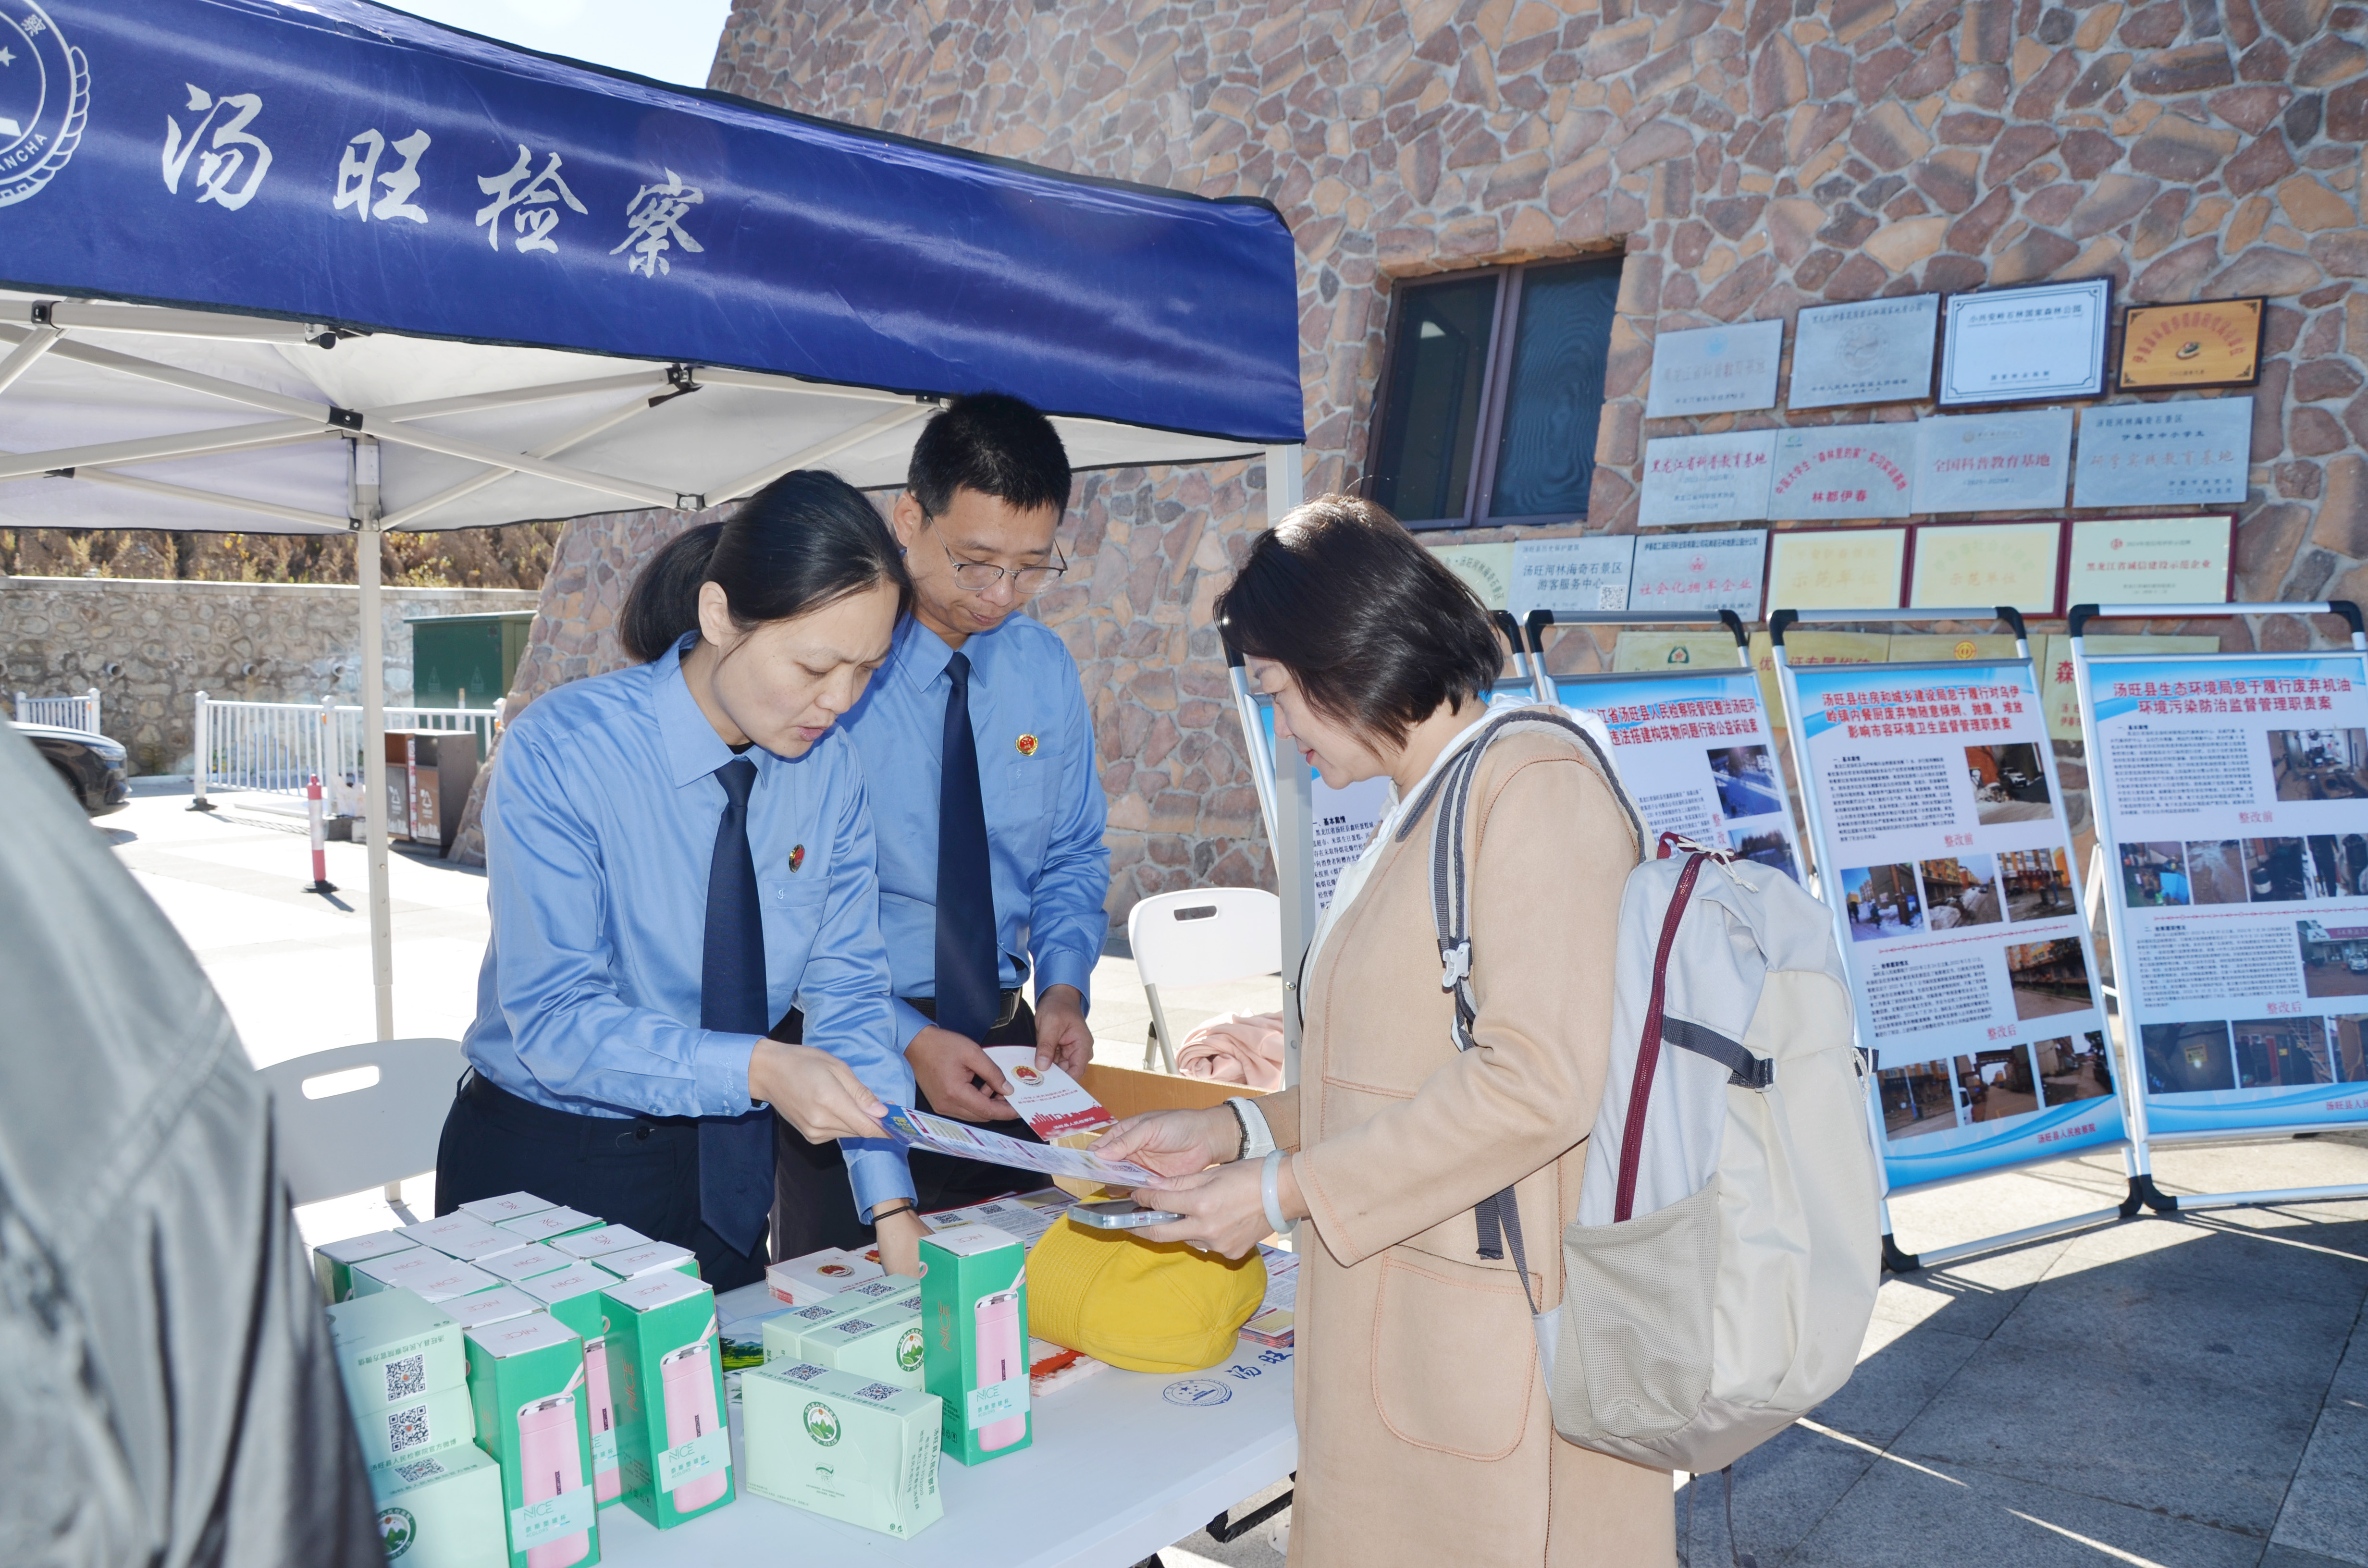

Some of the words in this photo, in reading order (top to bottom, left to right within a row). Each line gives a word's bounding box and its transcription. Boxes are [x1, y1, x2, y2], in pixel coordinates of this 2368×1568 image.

[161, 82, 704, 279] 汤旺检察
[1933, 453, 2051, 473] 全国科普教育基地
[1812, 489, 1868, 503] 林都伊春
[1523, 562, 1623, 576] 汤旺河林海奇石景区
[1537, 577, 1604, 590] 游客服务中心
[1640, 578, 1753, 596] 社会化拥军企业
[1822, 686, 2019, 706] 汤旺县住房和城乡建设局怠于履行对乌伊
[2114, 678, 2352, 698] 汤旺县生态环境局怠于履行废弃机油
[1586, 698, 1757, 724] 江省汤旺县人民检察院督促整治汤旺河
[2138, 696, 2333, 714] 环境污染防治监督管理职责案
[1848, 718, 2012, 739] 影响市容环境卫生监督管理职责案
[2238, 810, 2273, 824] 整改前
[1944, 833, 1973, 847] 整改前
[2267, 1001, 2303, 1014] 整改后
[1988, 1024, 2017, 1041] 整改后
[953, 1234, 985, 1244] NICE
[550, 1276, 585, 1289] NICE
[634, 1283, 669, 1296] NICE
[500, 1327, 539, 1340] NICE
[976, 1385, 1000, 1402] NICE
[668, 1442, 695, 1464] NICE
[928, 1427, 940, 1496] 汤旺县人民检察院
[523, 1500, 555, 1521] NICE
